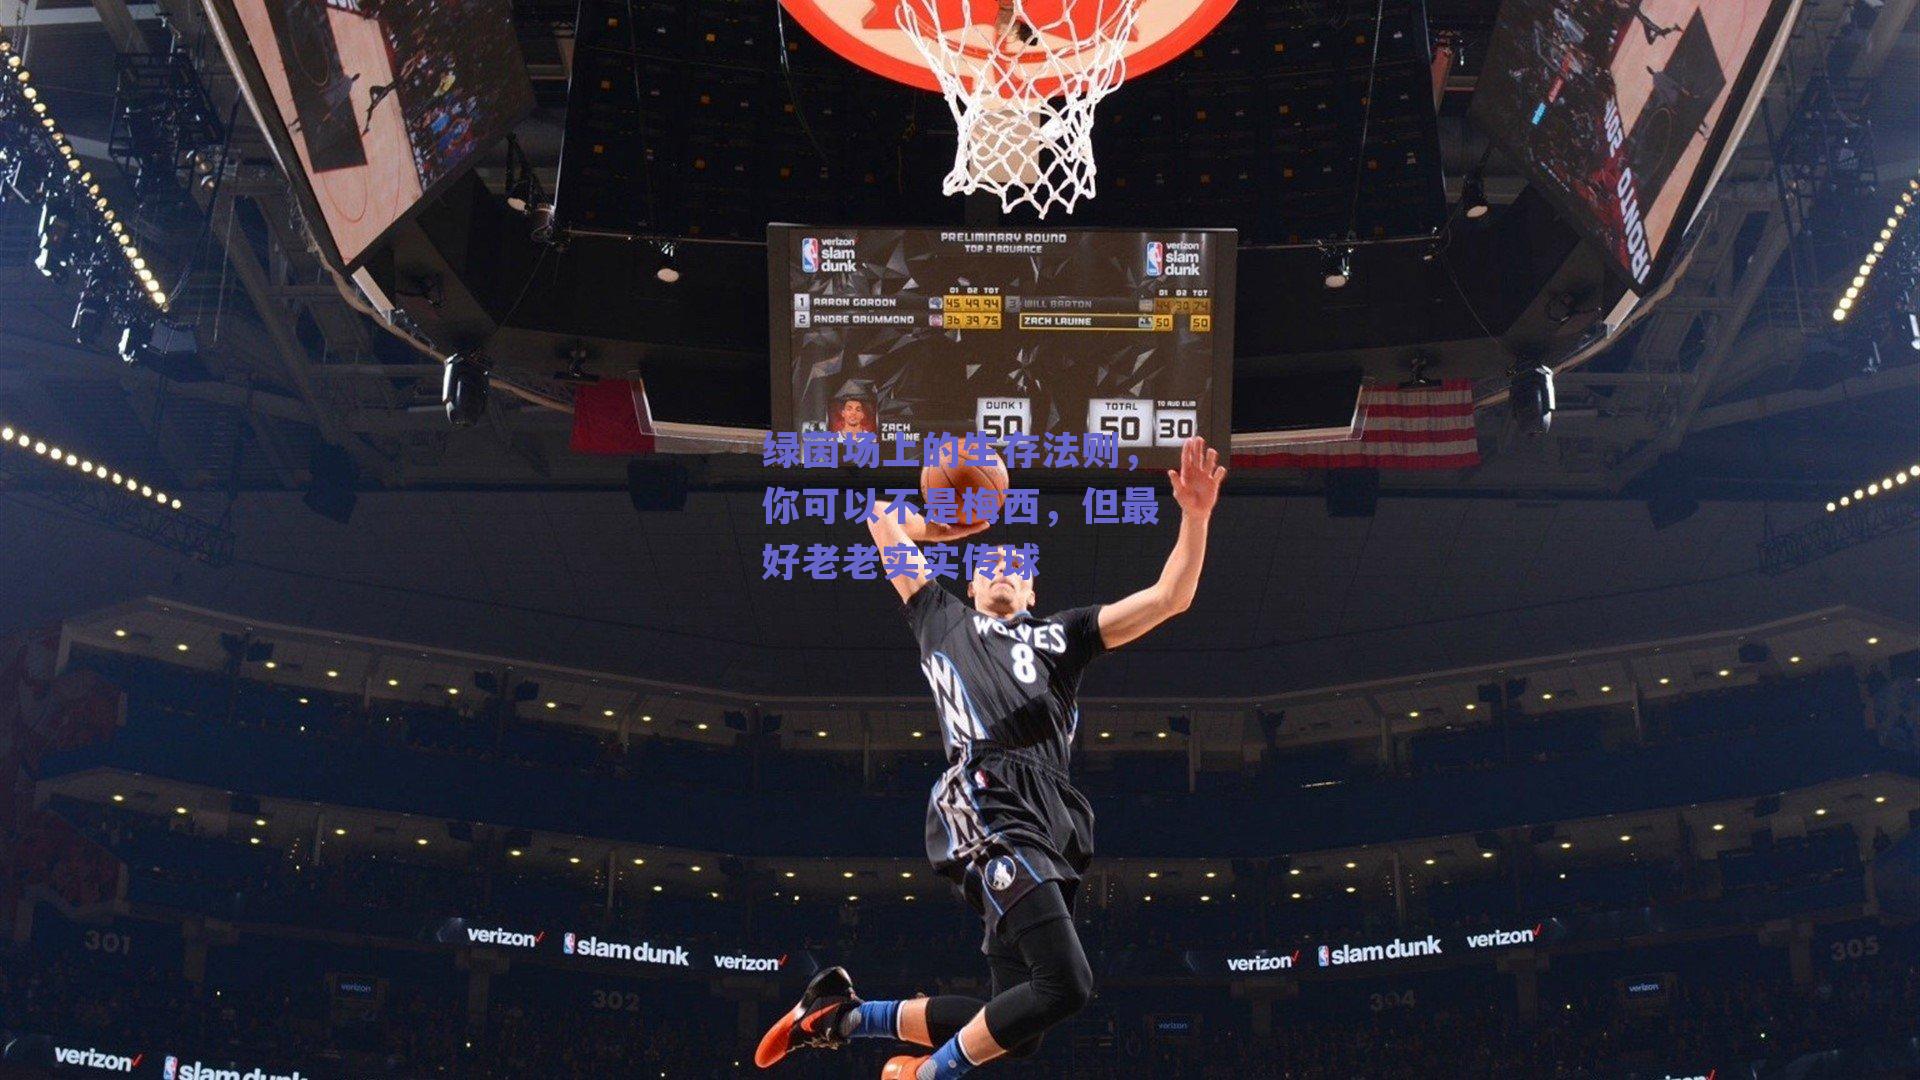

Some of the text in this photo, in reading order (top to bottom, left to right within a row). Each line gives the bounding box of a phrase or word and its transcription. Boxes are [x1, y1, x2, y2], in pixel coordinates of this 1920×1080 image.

[1617, 166, 1651, 284] RONTO
[821, 237, 855, 246] verizon
[940, 232, 1068, 243] PRELIMINARY ROUND
[964, 244, 985, 253] TOP
[986, 244, 994, 253] 2
[1165, 241, 1200, 250] verizon
[821, 246, 855, 259] slam
[1165, 250, 1200, 263] slam
[821, 260, 857, 272] dunk
[1164, 263, 1201, 276] dunk
[983, 286, 999, 294] TOT
[813, 298, 850, 307] AARON
[853, 298, 897, 307] GORDON
[946, 298, 960, 308] 45
[965, 298, 980, 308] 49
[984, 299, 999, 308] 94
[1050, 300, 1092, 309] BARTON
[799, 314, 806, 324] 2
[814, 315, 850, 324] ANDRE
[852, 315, 915, 325] DRUMMOND
[966, 315, 980, 325] 39
[984, 315, 999, 326] 75
[1024, 317, 1208, 328] ZACH LAVINE 50 50
[986, 401, 1017, 409] DUNK
[1105, 402, 1138, 411] TOTAL
[881, 423, 911, 432] ZACH
[983, 415, 1023, 441] 50
[1100, 416, 1140, 441] 50
[1159, 418, 1193, 438] 30
[881, 433, 920, 442] LAINE
[1010, 643, 1037, 684] 8
[84, 929, 132, 956] 301
[467, 927, 536, 948] verizon
[1466, 929, 1534, 948] verizon
[576, 935, 690, 966] slam dunk
[1331, 934, 1443, 965] slam dunk
[1830, 935, 1881, 962] 305
[713, 954, 780, 971] verizon
[1227, 955, 1292, 971] verizon
[54, 1046, 132, 1073] verizon
